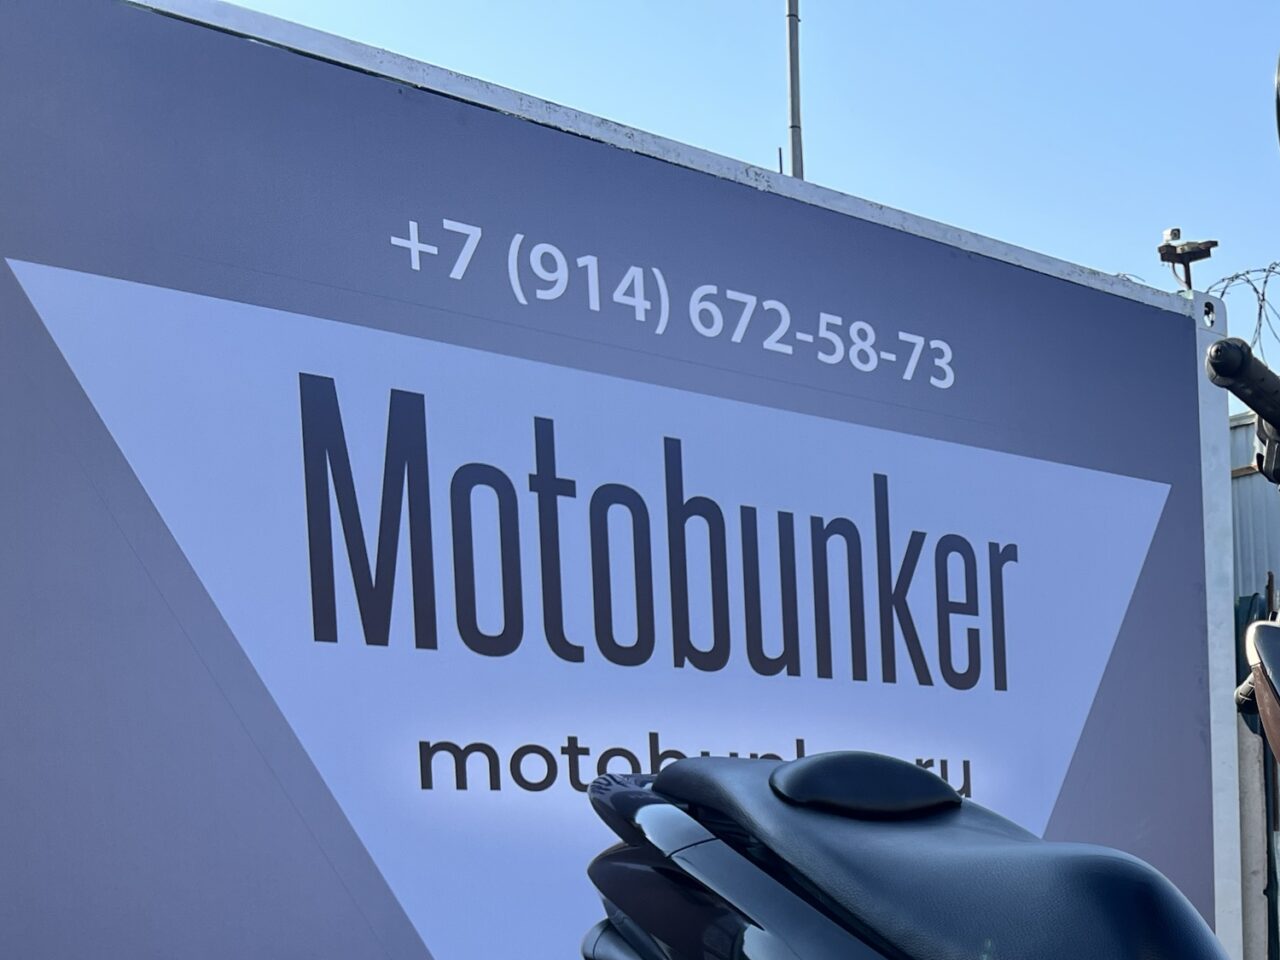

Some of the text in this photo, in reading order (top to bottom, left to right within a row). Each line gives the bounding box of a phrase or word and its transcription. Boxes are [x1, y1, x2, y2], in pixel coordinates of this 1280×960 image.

[390, 219, 955, 389] +7 (914) 672-58-73
[298, 371, 1019, 692] Motobunker
